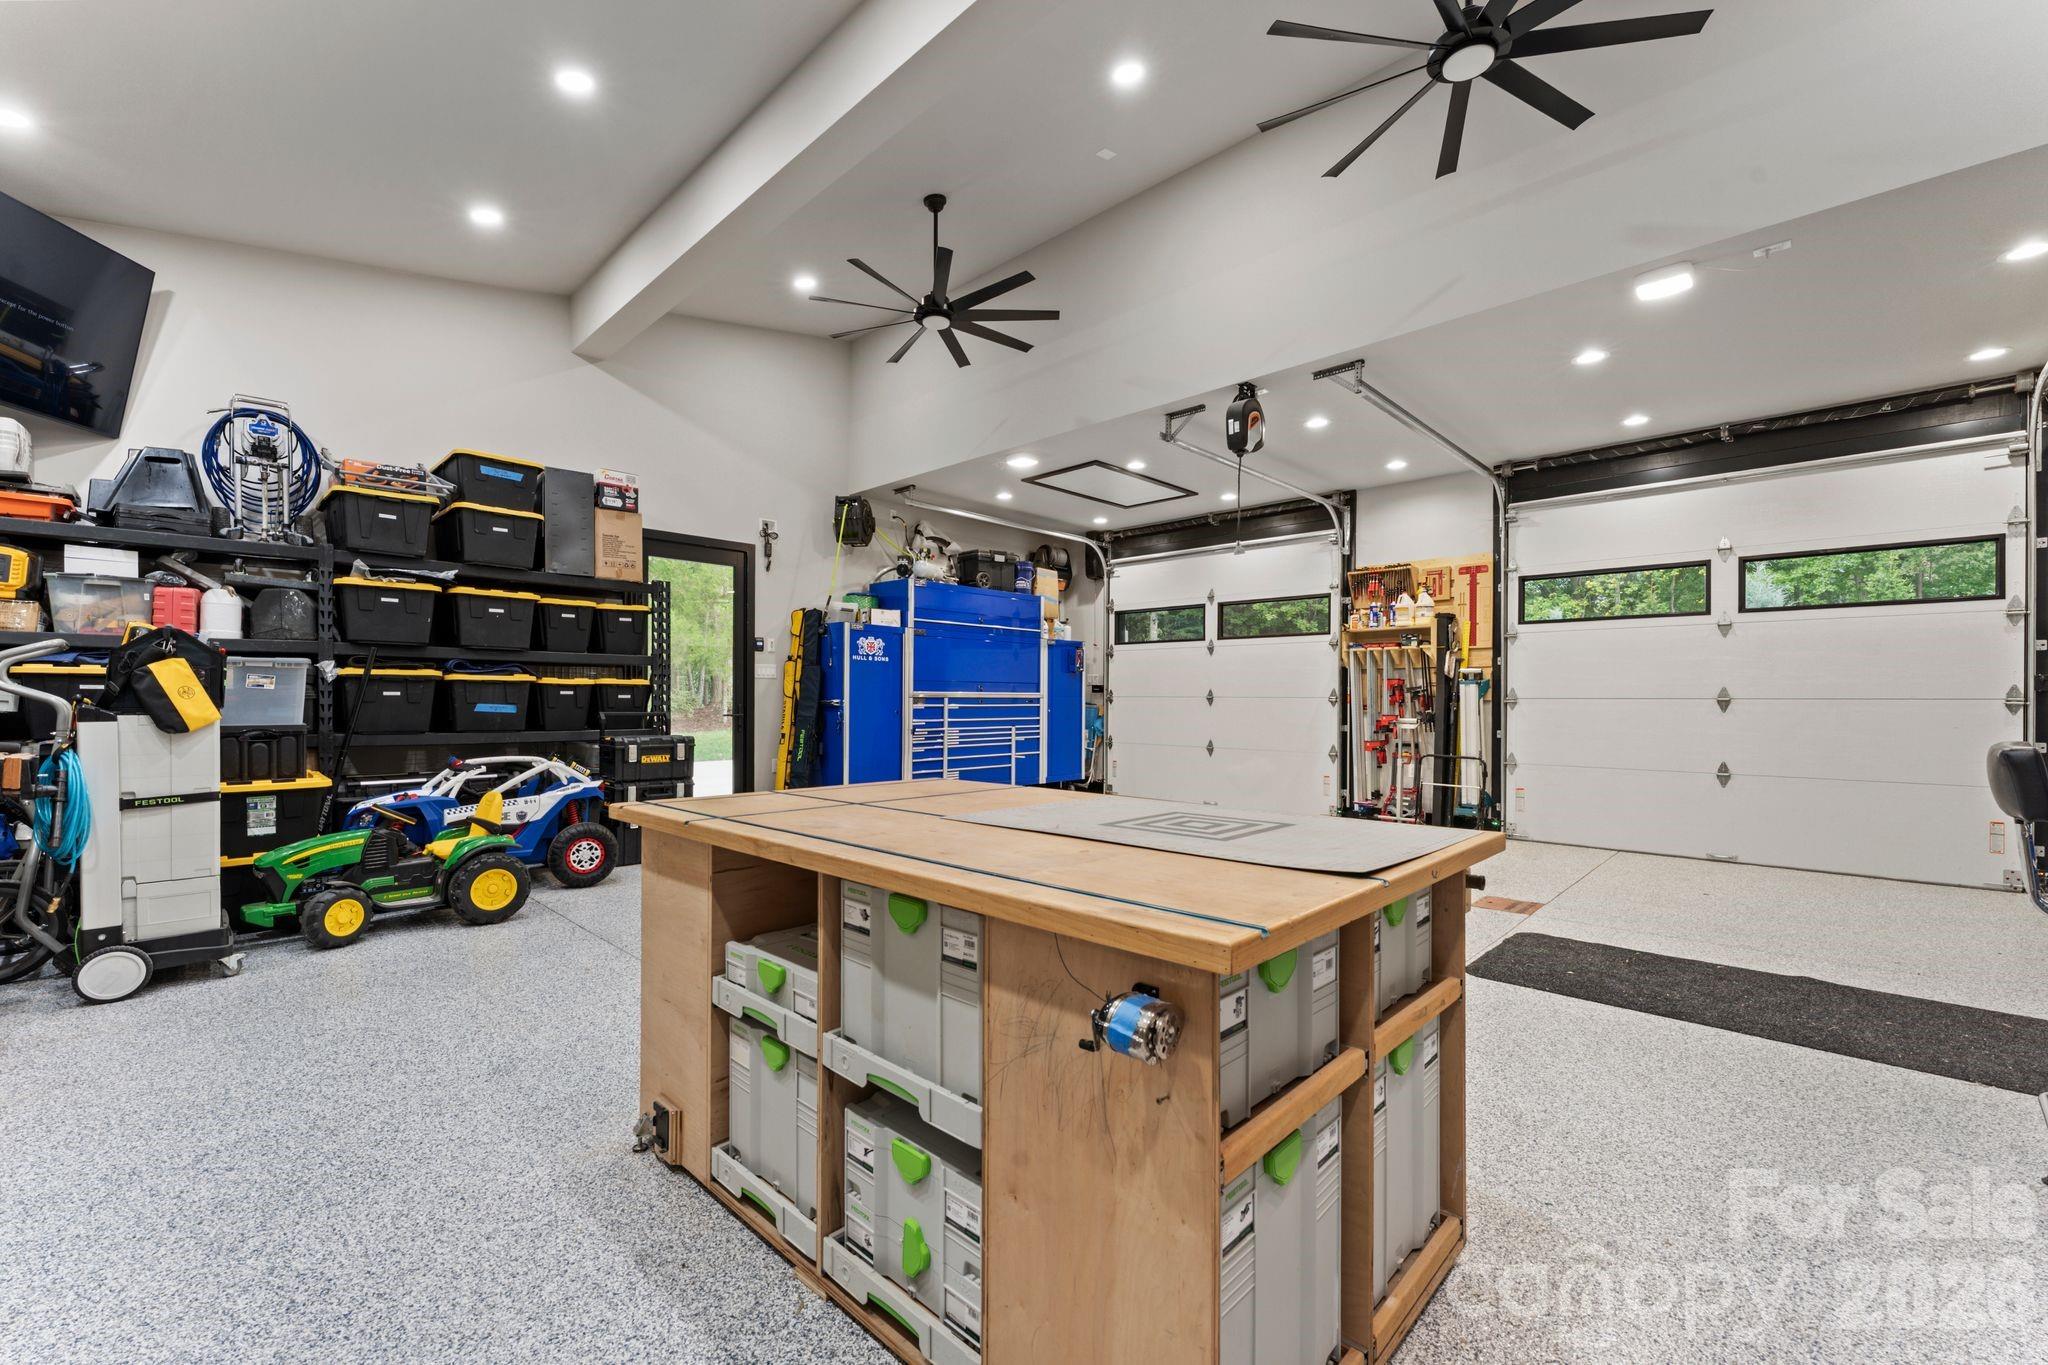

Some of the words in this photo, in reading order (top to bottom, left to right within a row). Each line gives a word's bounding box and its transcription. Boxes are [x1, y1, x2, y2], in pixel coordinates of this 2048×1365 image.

[38, 314, 55, 324] power
[376, 464, 410, 474] Dust-Free
[796, 729, 806, 762] FESTOOL
[134, 796, 185, 807] FESTOOL
